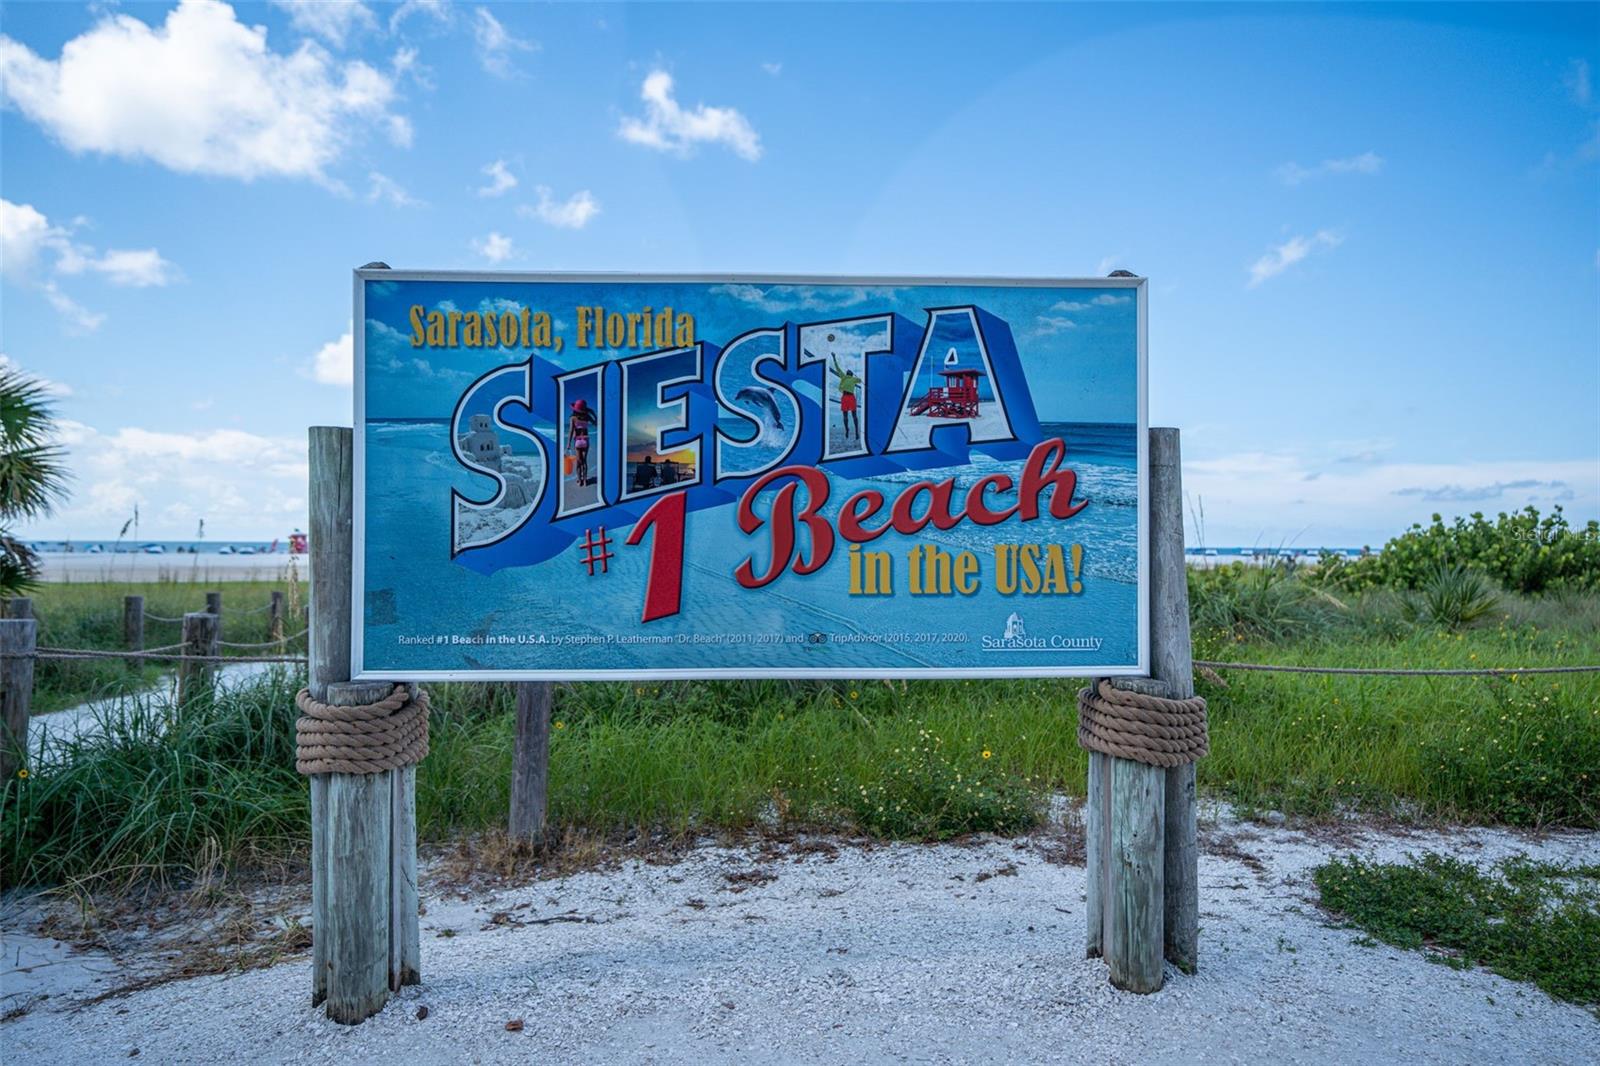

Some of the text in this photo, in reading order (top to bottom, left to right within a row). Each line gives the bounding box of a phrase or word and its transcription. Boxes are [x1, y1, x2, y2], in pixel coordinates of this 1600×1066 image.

[409, 305, 694, 352] Sarasota, Florida
[451, 304, 1018, 560] SIESTA
[734, 437, 1089, 588] Beach
[848, 543, 1084, 595] in the USA!
[398, 634, 434, 645] Ranked
[436, 635, 449, 645] #1
[452, 635, 484, 645] Beach
[486, 634, 496, 645] in
[498, 634, 516, 645] the
[518, 634, 549, 645] U.S.A.
[551, 634, 565, 646] by
[565, 633, 605, 646] Stephen
[607, 634, 614, 644] P.
[616, 633, 673, 644] Leatherman
[727, 632, 756, 646] (2011,
[758, 632, 783, 645] 2017)
[785, 632, 804, 644] and
[830, 632, 882, 645] TripAdvisor
[884, 632, 912, 645] (2015,
[914, 632, 939, 644] 2017,
[941, 632, 970, 644] 2020).
[981, 634, 1103, 651] Sarasota County
